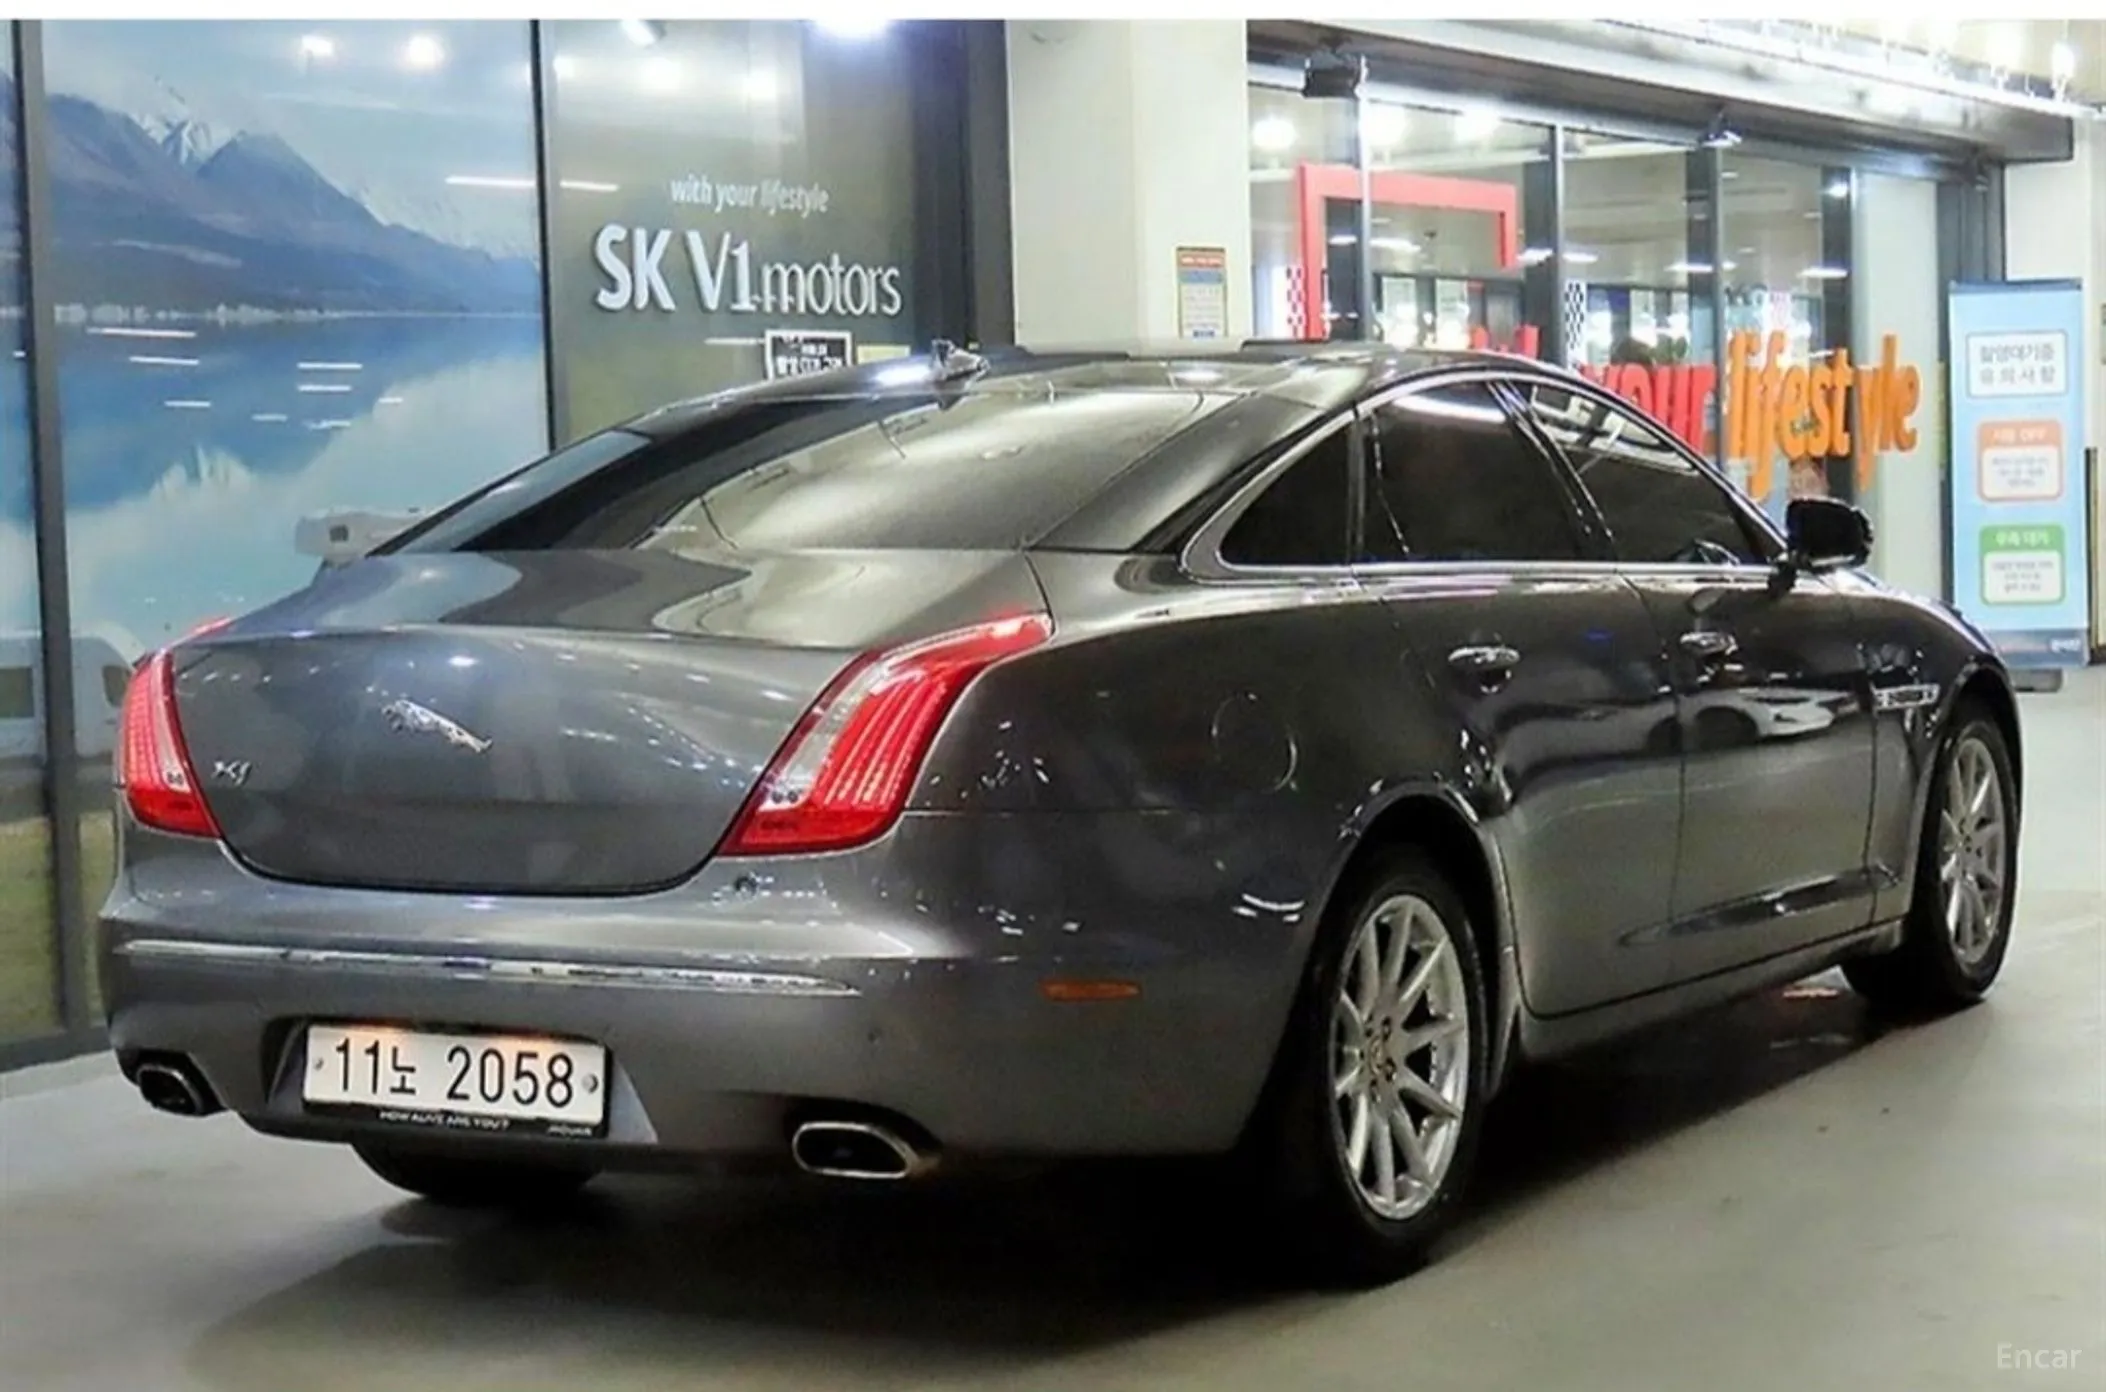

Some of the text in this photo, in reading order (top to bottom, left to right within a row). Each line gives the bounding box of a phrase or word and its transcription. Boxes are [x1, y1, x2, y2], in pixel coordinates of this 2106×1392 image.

[670, 173, 829, 218] with your lifestyle
[595, 224, 676, 312] SK
[761, 254, 901, 316] motors
[1728, 328, 1920, 499] lifestyle
[336, 1037, 574, 1109] 11노 2058
